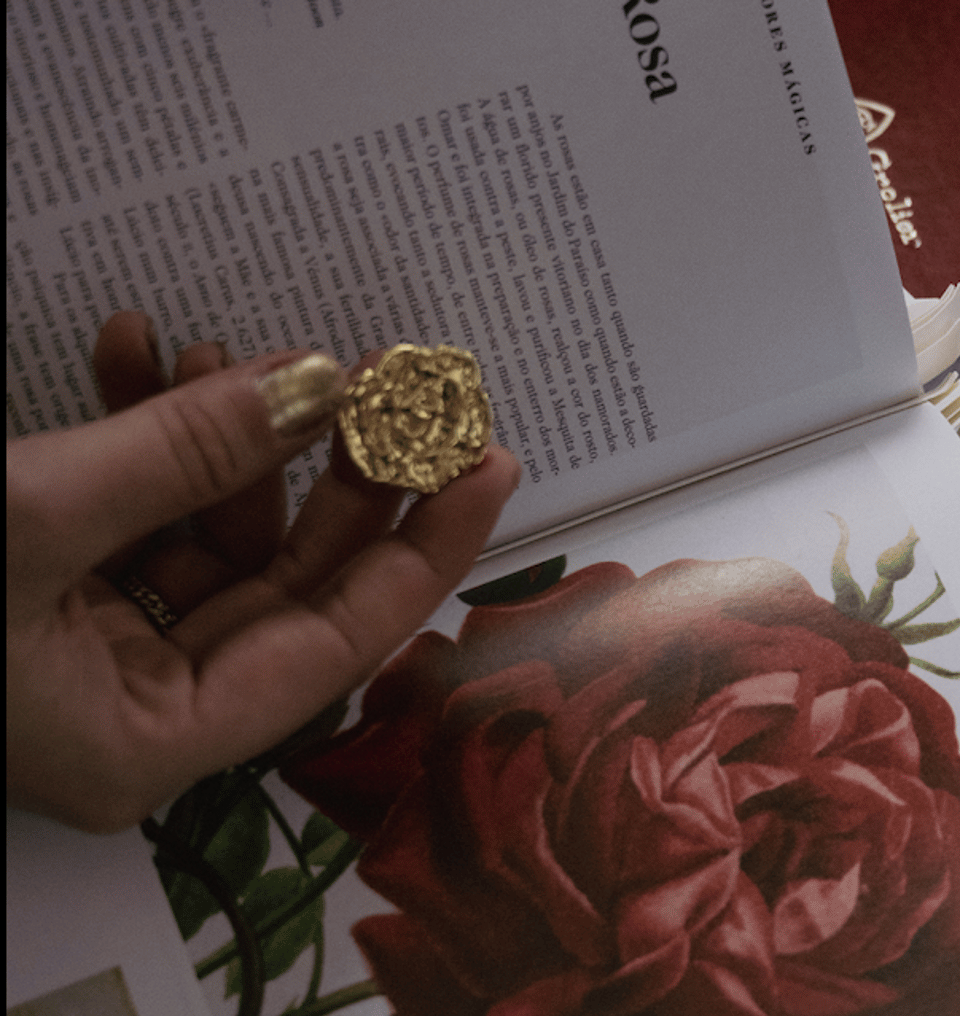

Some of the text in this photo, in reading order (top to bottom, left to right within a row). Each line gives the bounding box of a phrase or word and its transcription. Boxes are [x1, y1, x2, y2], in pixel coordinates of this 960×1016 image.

[780, 60, 817, 156] MÁGICAS
[101, 214, 132, 281] até serem
[123, 207, 144, 248] Lúcio
[139, 252, 157, 284] num
[157, 237, 180, 283] contra
[175, 288, 192, 318] uma
[228, 175, 283, 309] deusa nascendo do
[249, 168, 314, 336] na mais famosa pintura
[271, 161, 306, 242] Consagrada
[305, 256, 325, 300] Vénus
[291, 156, 344, 290] sensualidade, sua
[310, 149, 374, 310] predominantemente da
[337, 154, 404, 335] rosa seja associada várias
[353, 135, 408, 273] tra como da
[386, 162, 415, 228] evocando
[408, 230, 427, 266] tanto
[425, 280, 450, 337] sedutora
[395, 123, 476, 346] maior período de tempo, de entre
[498, 91, 618, 453] rar um florido presente vitoriano no dia dos namorados.
[515, 84, 636, 448] por anjos no Jardim do Paraíso como quando estão deco-
[550, 114, 657, 442] As rosas estão em casa tanto quando são guardadas
[53, 272, 77, 324] Para os
[72, 271, 93, 302] para
[206, 311, 222, 328] de
[235, 258, 270, 342] Mãe sua
[415, 116, 543, 483] tos. perfume de rosas manteve-se mais popular, pelo
[437, 109, 559, 476] Omar foi integrada na preparação no enterro dos mor-
[456, 103, 582, 469] foi usada contra peste, lavou purificou Mesquita de
[481, 112, 598, 463] água de rosas, ou óleo de rosas, realçou cor do rosto,
